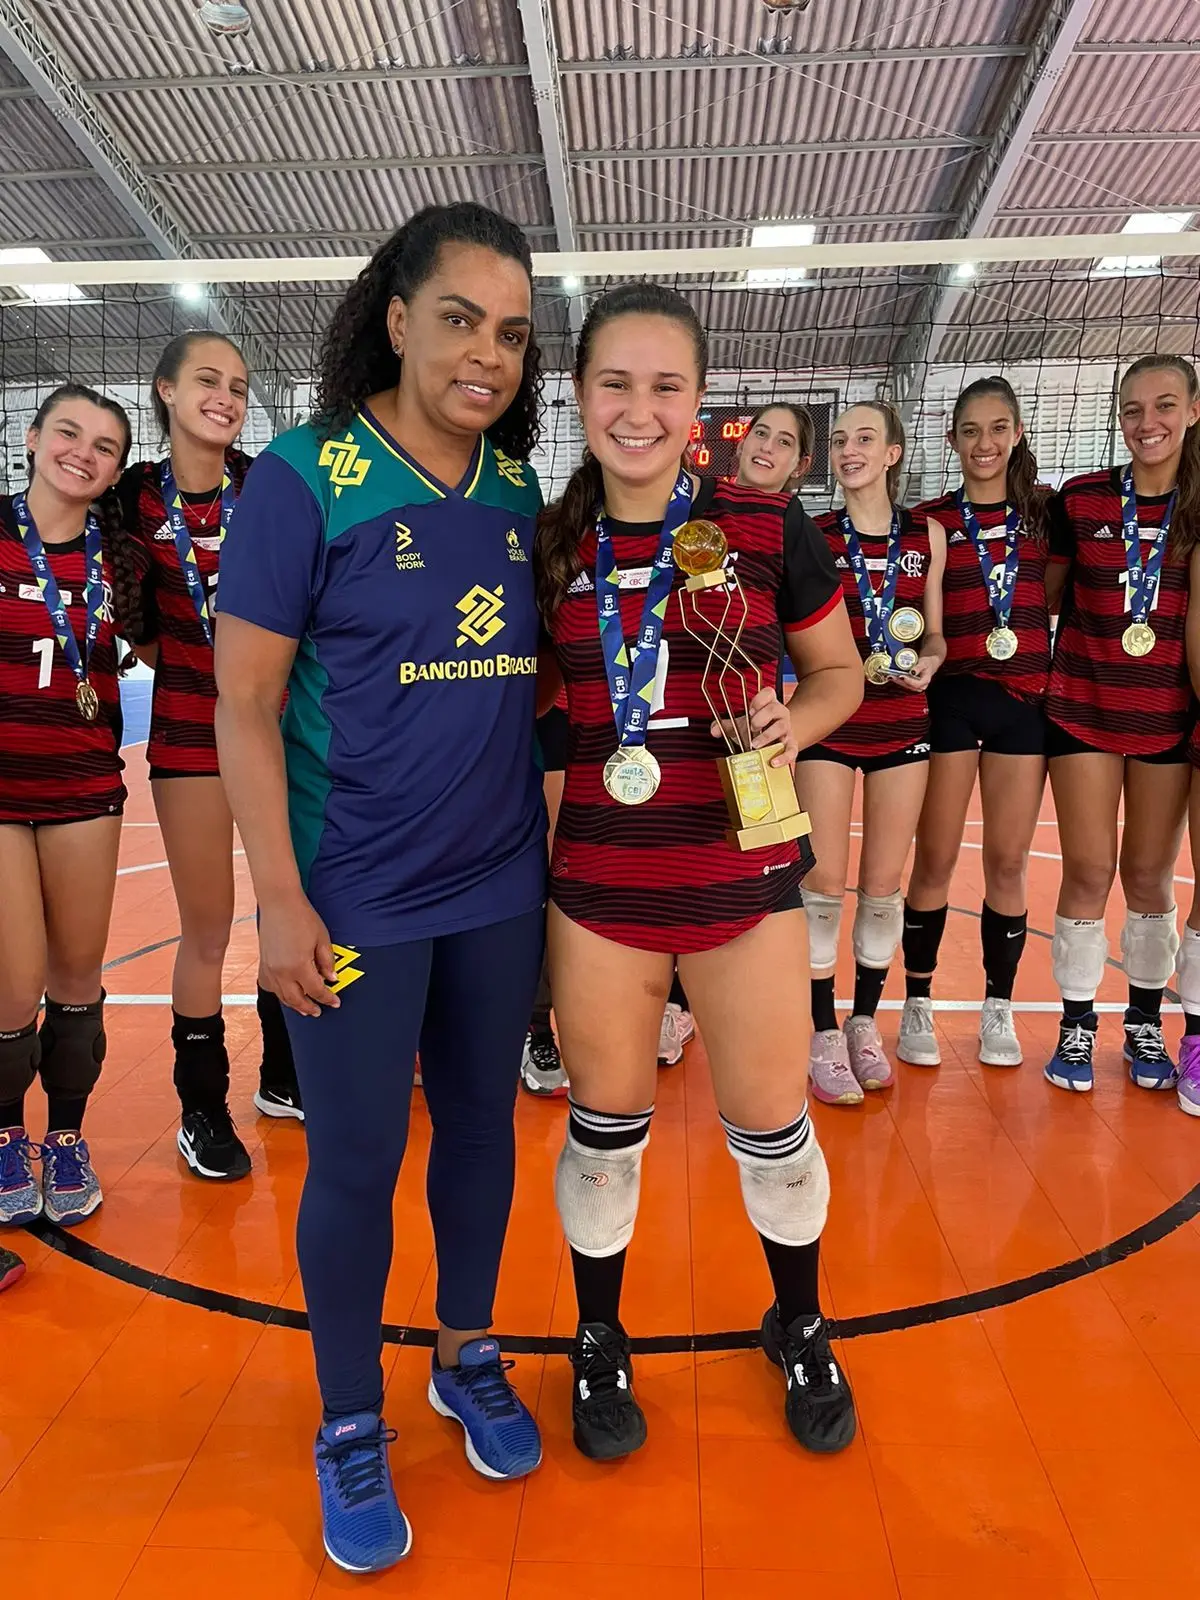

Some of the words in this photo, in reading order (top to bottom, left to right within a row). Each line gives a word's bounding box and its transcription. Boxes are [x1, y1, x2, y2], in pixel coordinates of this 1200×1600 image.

[395, 552, 421, 563] BODY
[662, 547, 673, 562] CBI
[396, 560, 426, 571] WORK
[604, 594, 613, 610] CBI
[643, 625, 654, 642] CBI
[32, 637, 55, 689] 1
[400, 661, 468, 685] BANCO
[470, 658, 494, 678] DO
[496, 654, 538, 676] BRASIL
[615, 675, 625, 693] CBI
[631, 708, 642, 726] CBI
